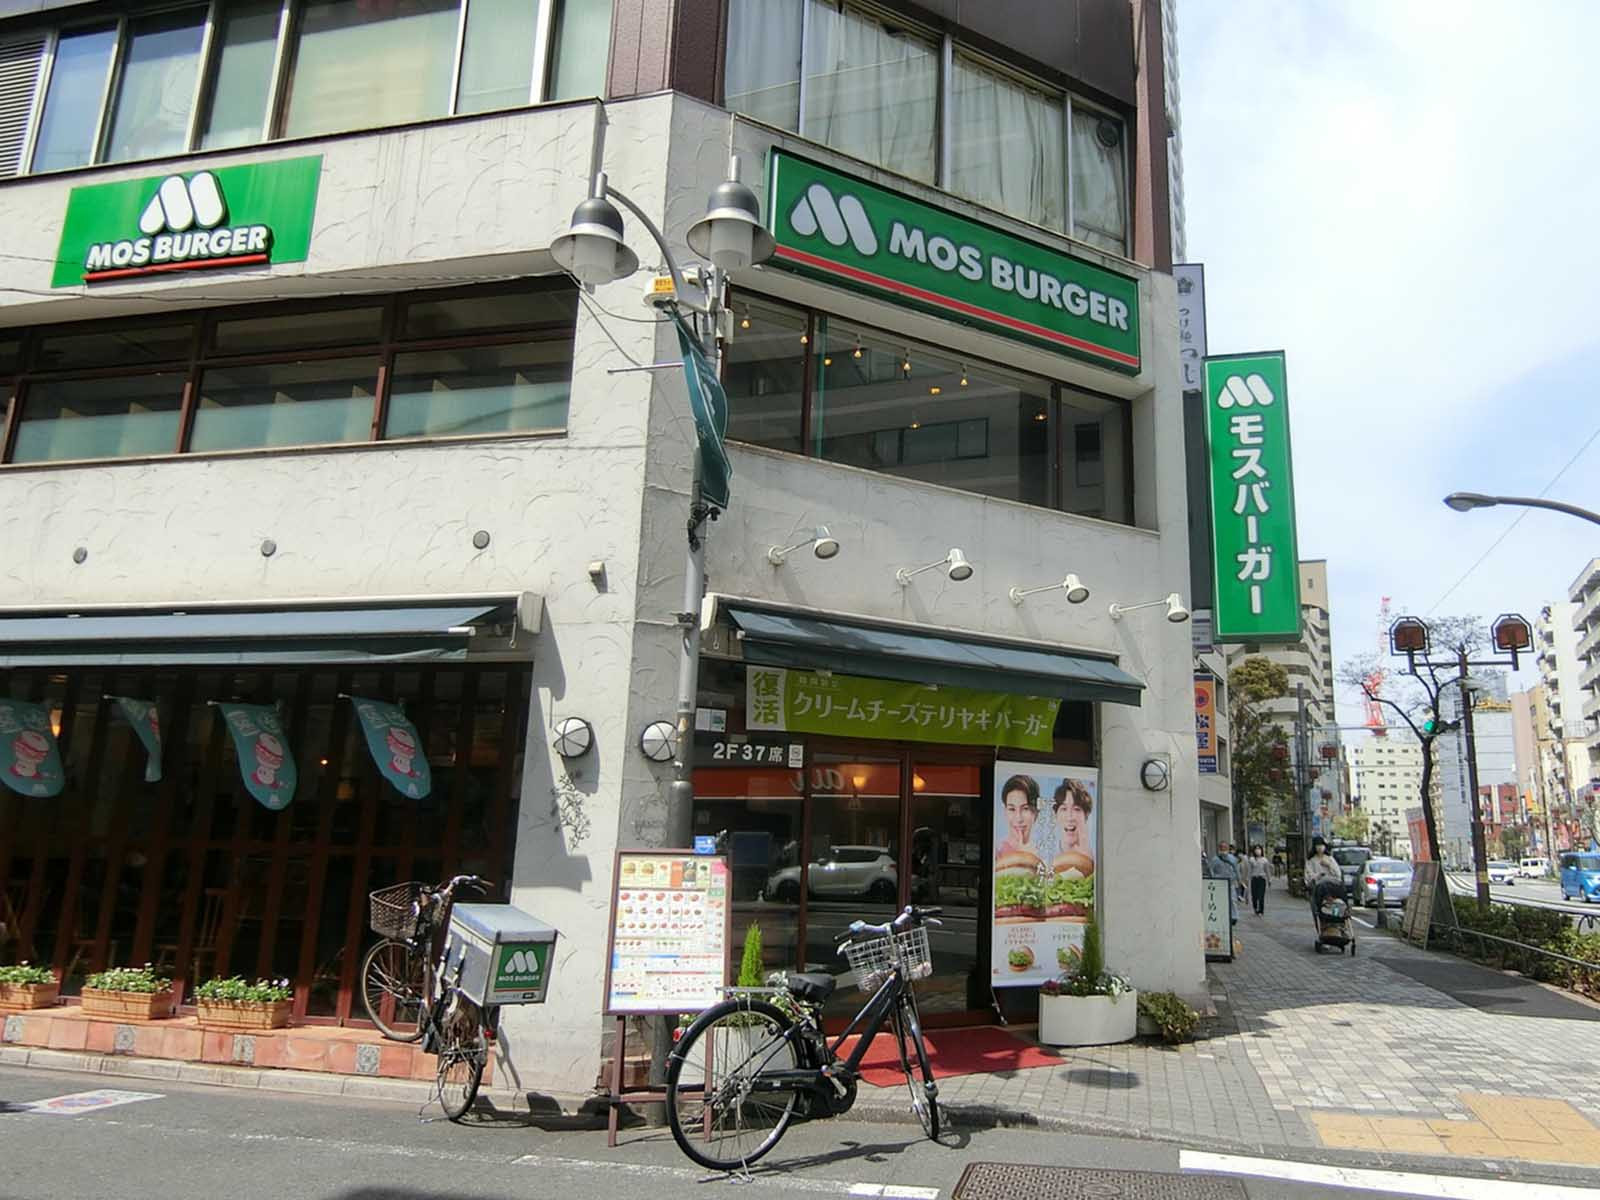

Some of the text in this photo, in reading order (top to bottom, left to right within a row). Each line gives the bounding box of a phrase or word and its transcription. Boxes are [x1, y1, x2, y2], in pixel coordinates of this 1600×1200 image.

[87, 226, 268, 270] MOS BURGER
[889, 222, 1129, 331] MOS BURGER
[1229, 415, 1272, 615] モスバーガー
[752, 671, 780, 725] 復活
[793, 691, 1048, 738] クリームチーズテリヤキバーガー
[1207, 881, 1217, 923] らーめん
